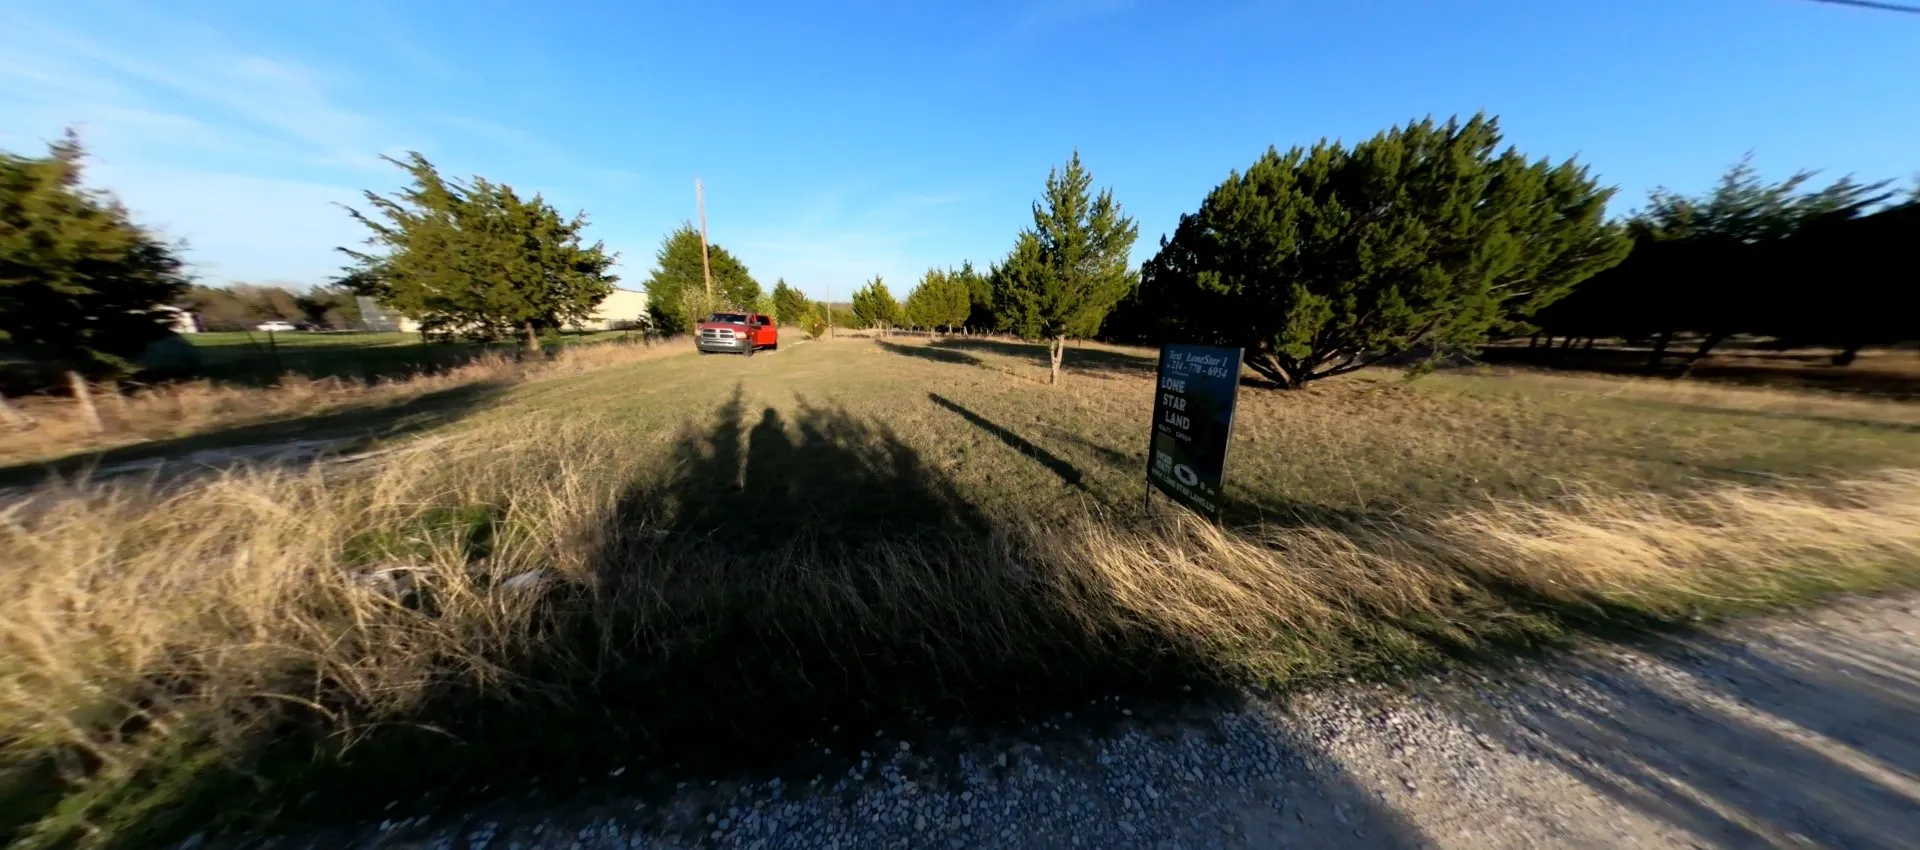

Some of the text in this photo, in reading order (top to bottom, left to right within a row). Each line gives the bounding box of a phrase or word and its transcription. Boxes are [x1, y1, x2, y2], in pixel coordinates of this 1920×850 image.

[1169, 350, 1183, 360] Text
[1186, 352, 1221, 366] LoneStar
[1161, 377, 1186, 393] LONE
[1162, 393, 1187, 412] STAR
[1164, 410, 1191, 430] LAND
